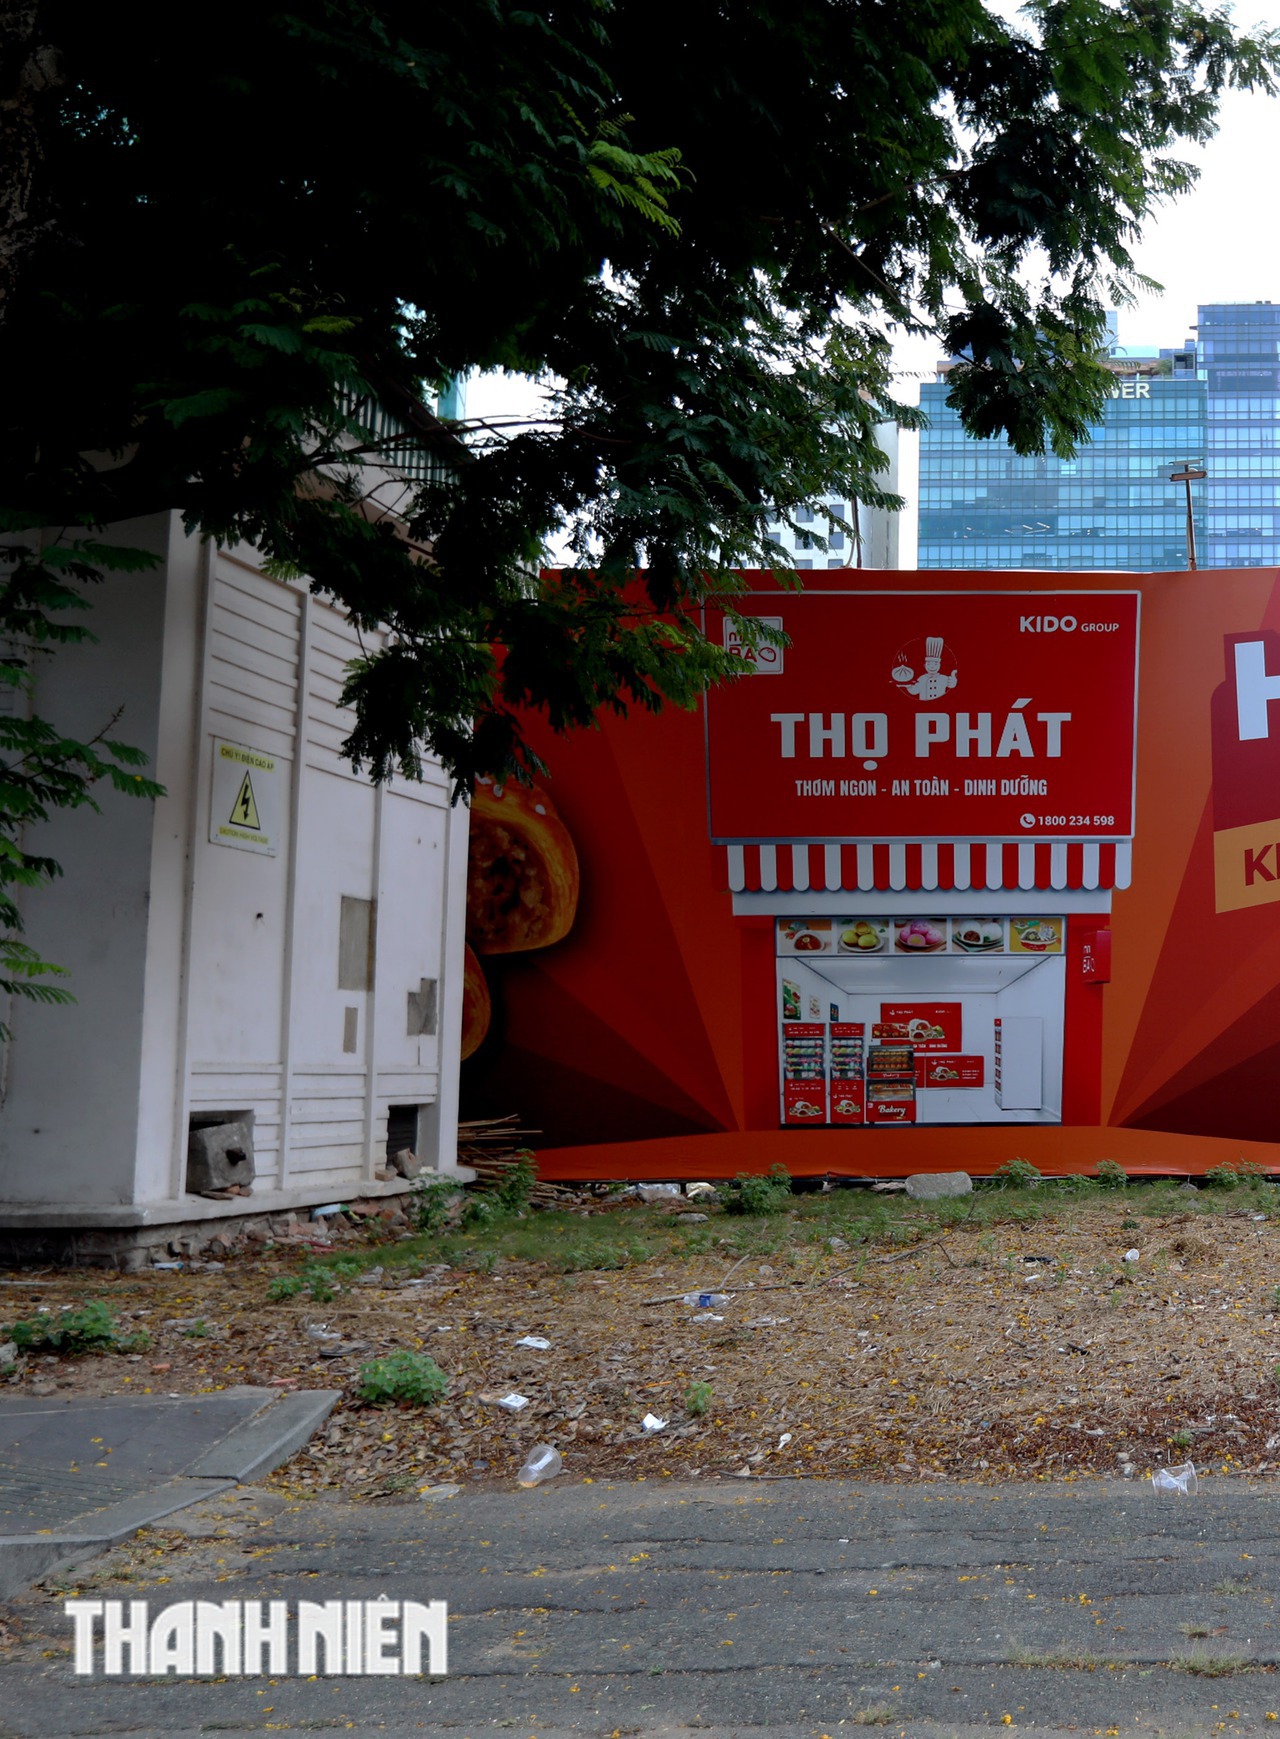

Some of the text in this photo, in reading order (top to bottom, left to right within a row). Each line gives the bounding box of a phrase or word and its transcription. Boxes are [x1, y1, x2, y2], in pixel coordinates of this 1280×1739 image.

[1101, 383, 1150, 399] WER
[1020, 615, 1119, 632] KIDO GROUP
[770, 697, 1072, 771] THỌ PHÁT
[795, 779, 835, 797] THƠM
[840, 780, 877, 796] NGON
[891, 780, 910, 796] AN
[914, 775, 949, 796] TOÀN
[964, 779, 996, 796] DINH
[1000, 774, 1047, 796] DƯỠNG
[1038, 816, 1115, 826] 1800 234 598
[878, 1105, 906, 1117] Bakery
